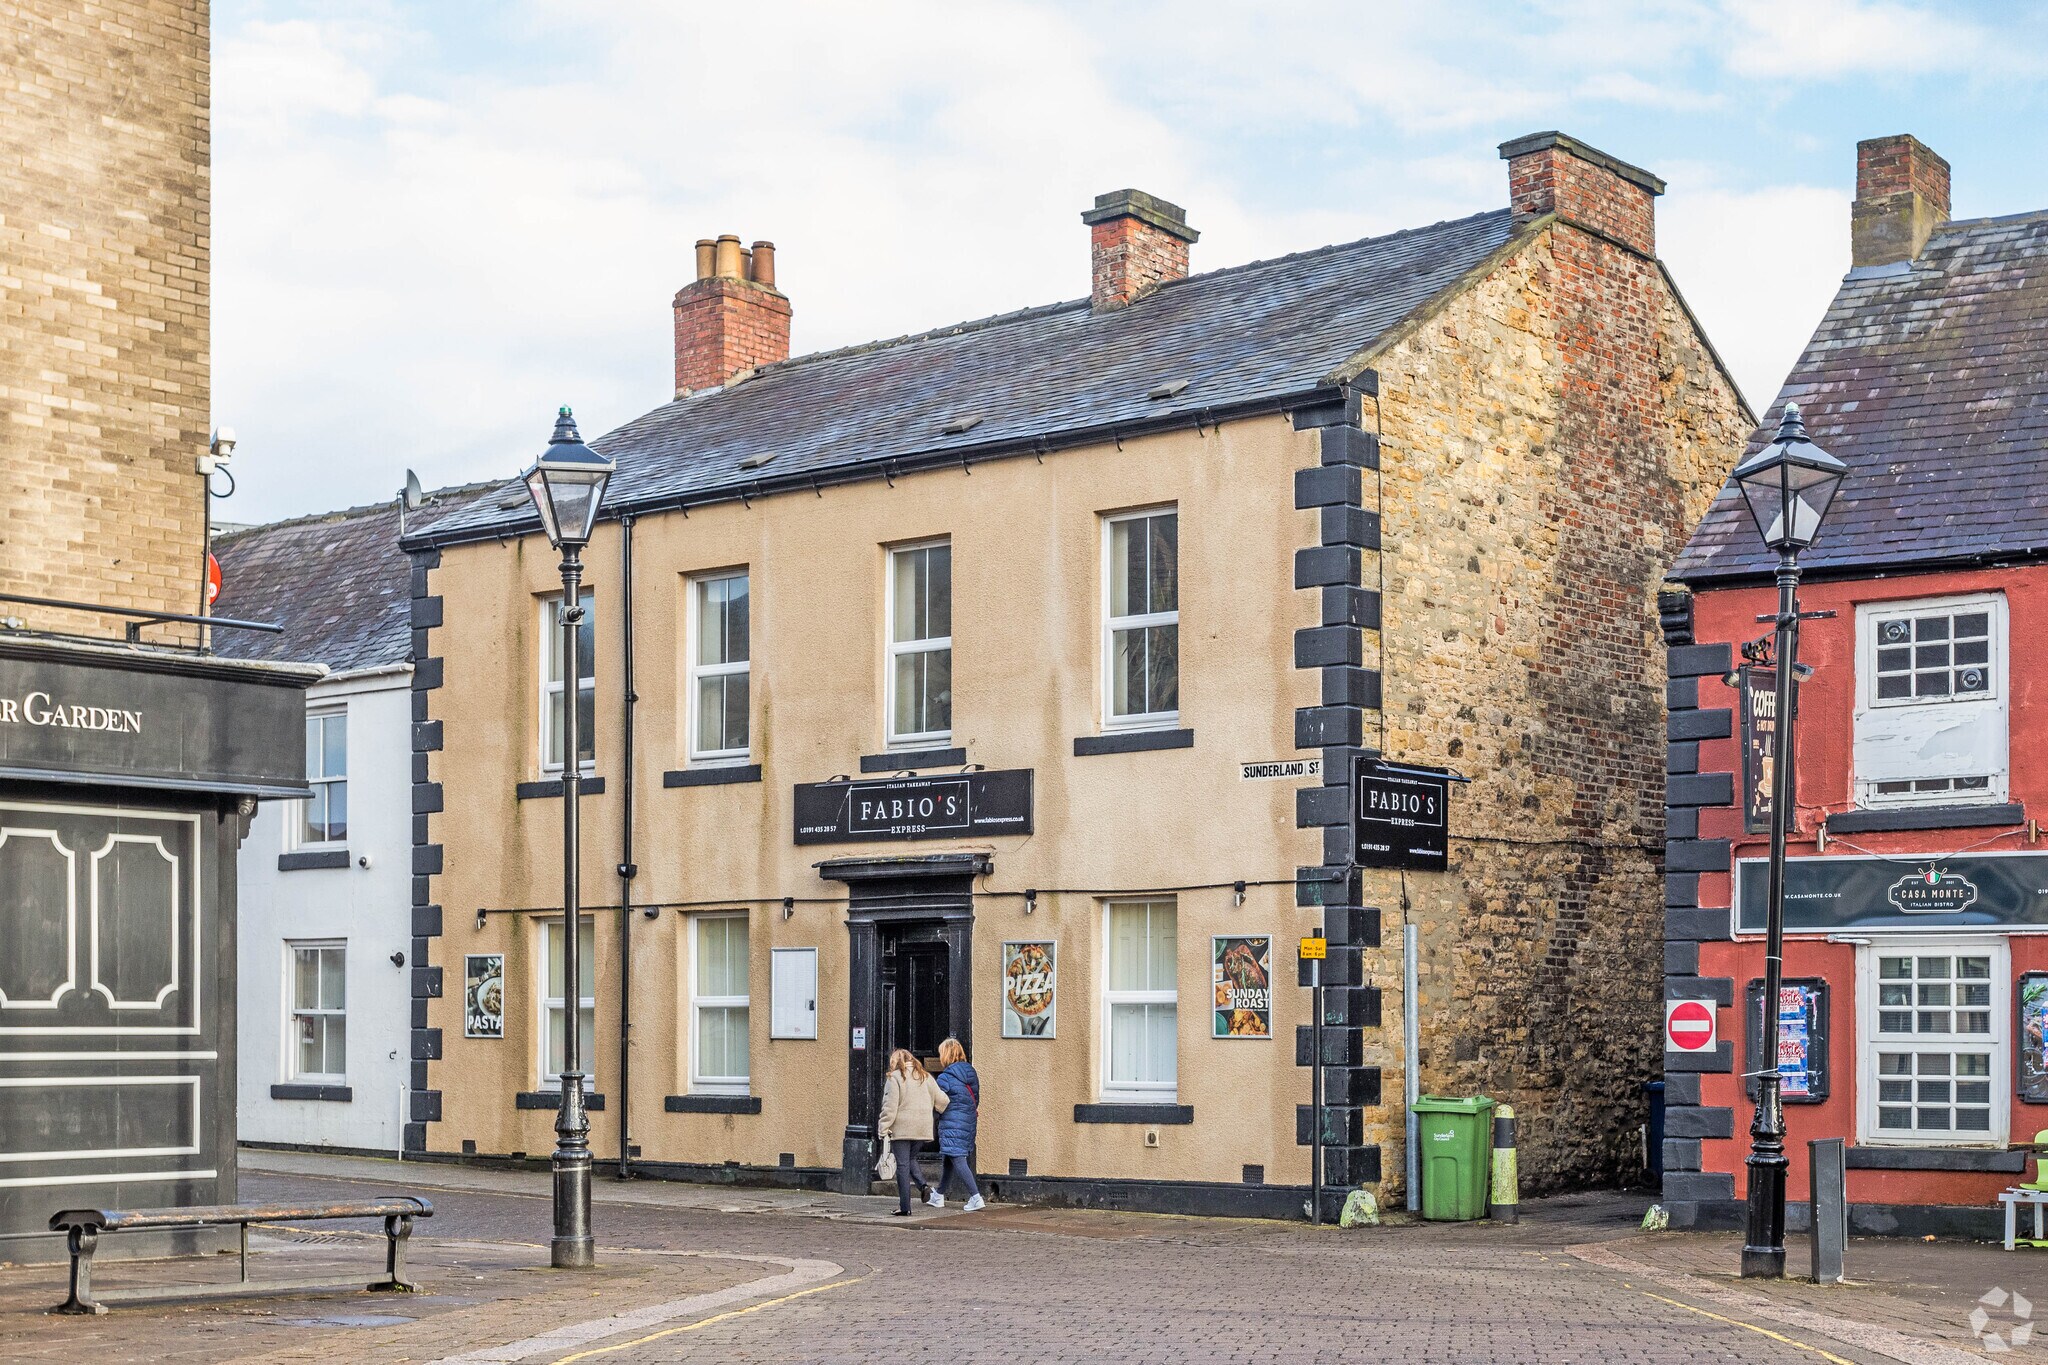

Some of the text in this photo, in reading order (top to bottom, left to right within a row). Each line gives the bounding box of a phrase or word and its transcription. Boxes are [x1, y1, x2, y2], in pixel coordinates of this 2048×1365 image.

[1753, 689, 1776, 718] COFFE
[0, 691, 143, 733] R GARDEN
[1243, 763, 1304, 779] SUNDERLAND
[860, 795, 957, 821] FABIO'S
[1369, 790, 1434, 815] FABIO'S
[891, 824, 926, 834] EXPRESS
[1390, 817, 1415, 827] EXPRESS
[1901, 889, 1964, 899] CASA MONTE
[1005, 971, 1054, 997] PIZZA
[1226, 988, 1270, 999] SUNDAY
[1235, 998, 1270, 1008] ROAST
[468, 1014, 502, 1030] PASTA
